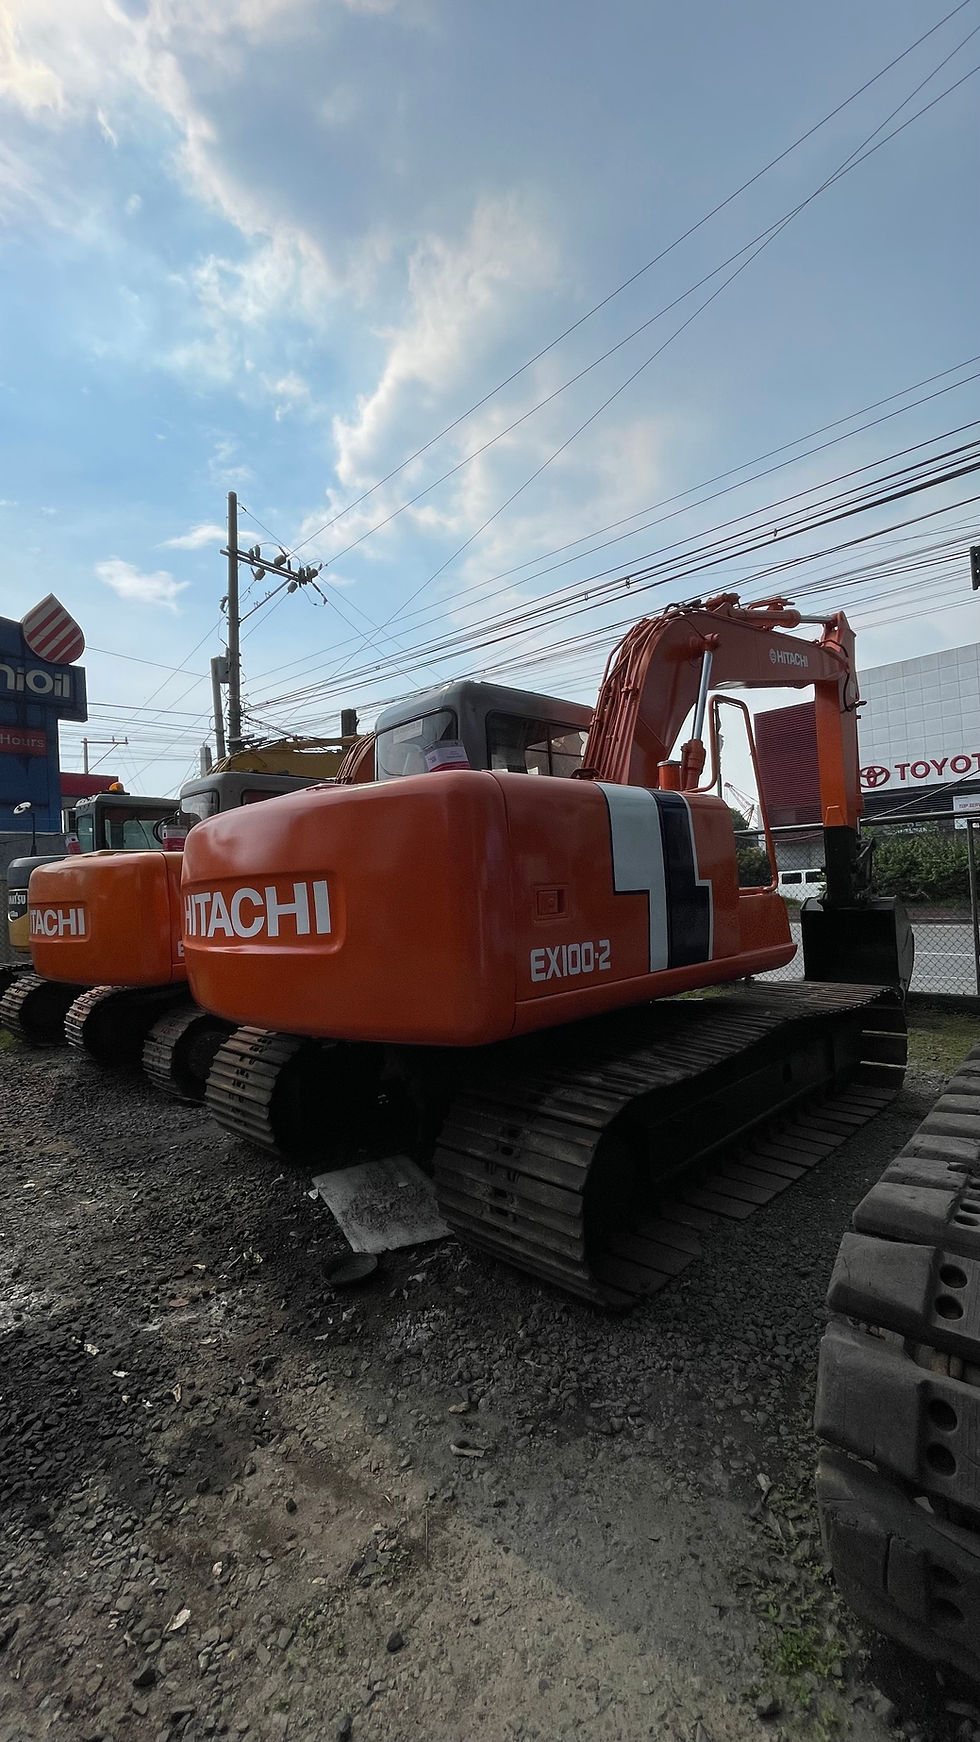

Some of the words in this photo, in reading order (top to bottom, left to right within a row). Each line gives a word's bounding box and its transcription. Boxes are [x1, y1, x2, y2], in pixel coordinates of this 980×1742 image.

[776, 650, 809, 668] HITACHI
[0, 733, 45, 748] Hours
[185, 881, 331, 938] HITACHI
[530, 939, 612, 982] EX100-2
